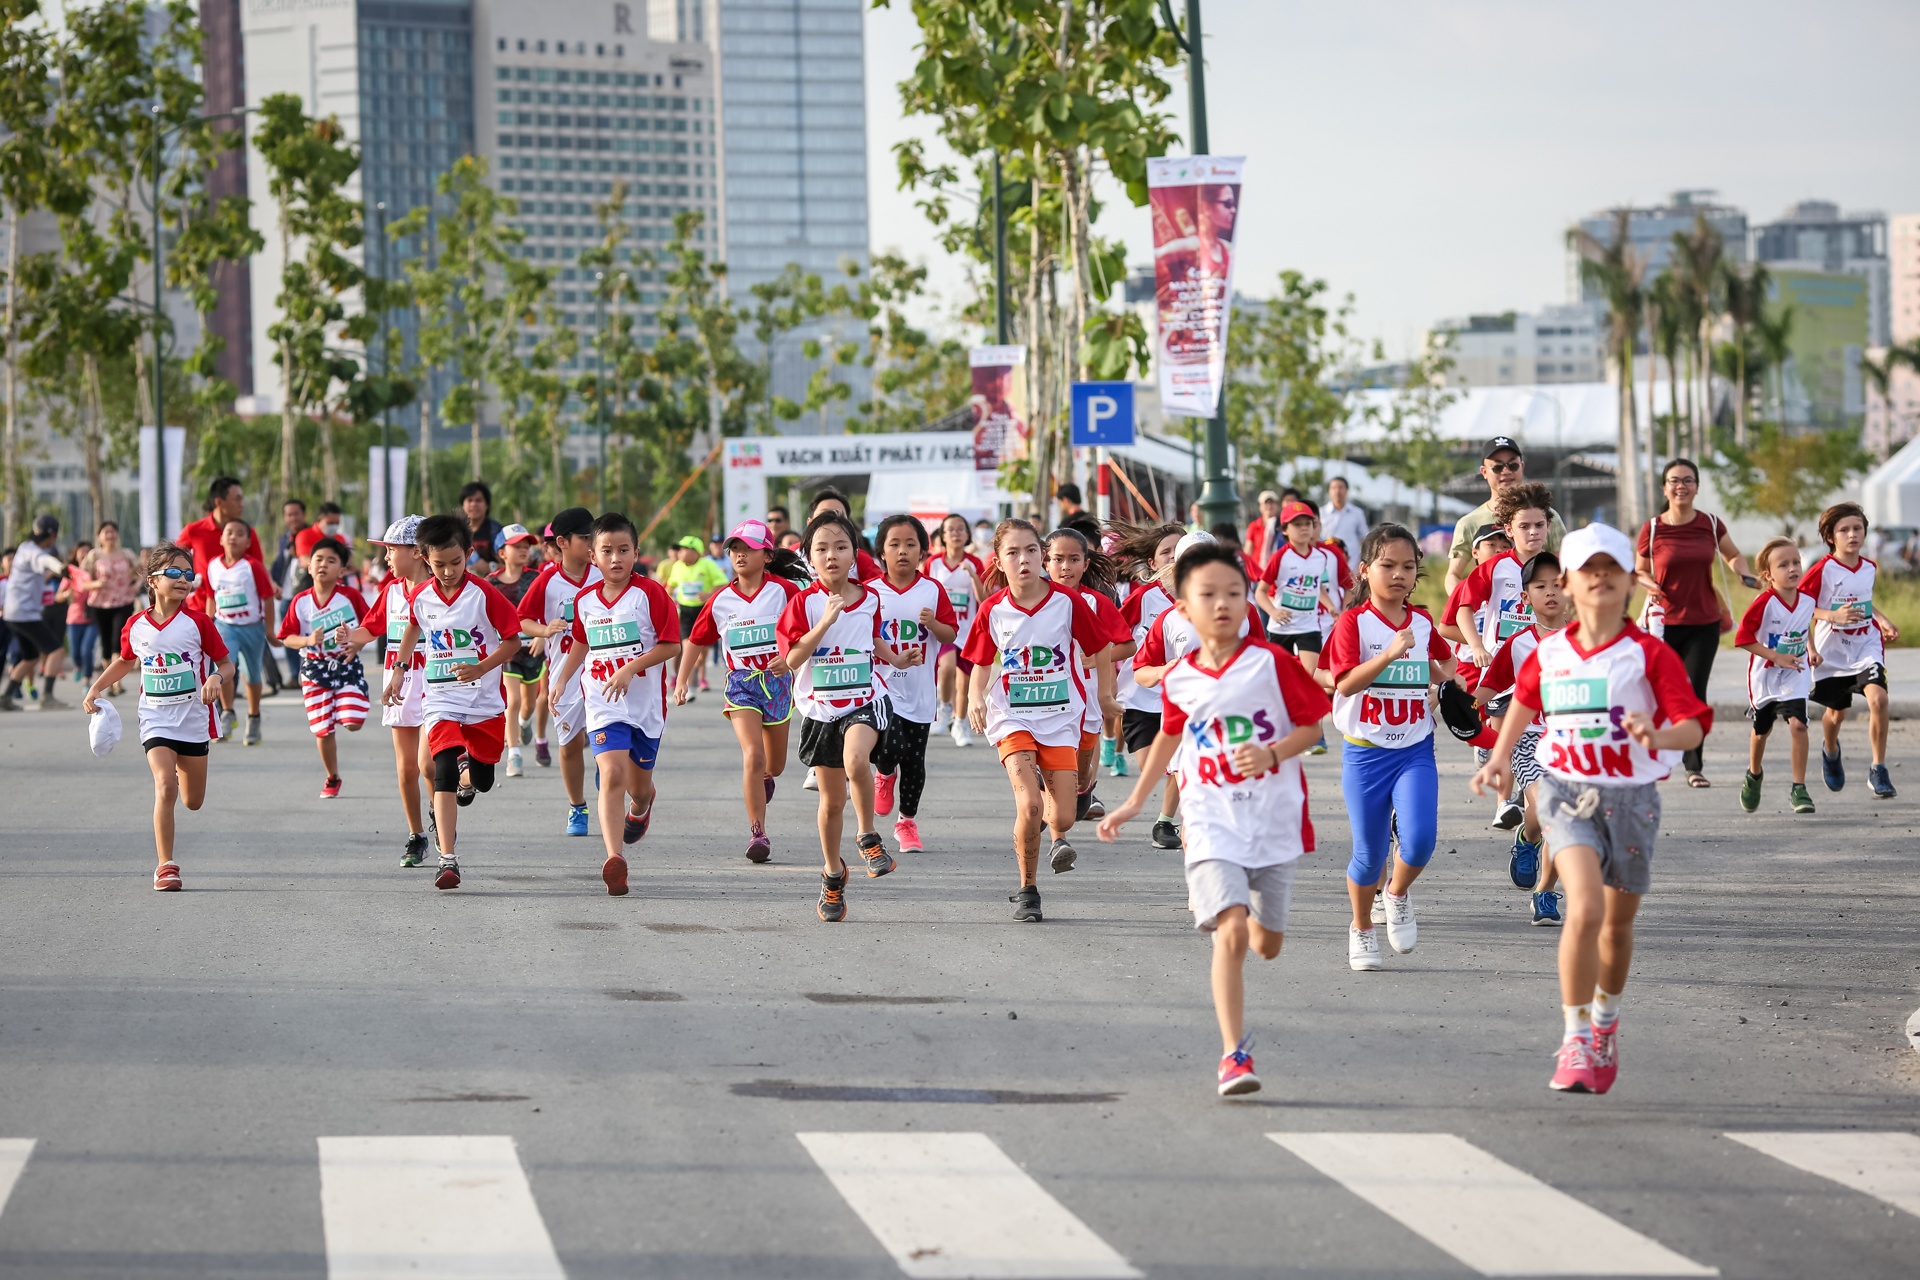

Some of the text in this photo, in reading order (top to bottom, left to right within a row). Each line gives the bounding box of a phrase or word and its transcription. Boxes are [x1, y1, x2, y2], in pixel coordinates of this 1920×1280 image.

[1088, 395, 1118, 433] P
[941, 446, 976, 466] VẠC
[1290, 596, 1312, 607] 7217
[320, 610, 345, 630] 7152
[1504, 612, 1531, 621] KIDSRUN
[431, 625, 484, 650] KIDS
[597, 626, 627, 645] 7158
[739, 627, 769, 643] 7170
[879, 618, 929, 642] KIDS
[1003, 644, 1066, 671] KIDS
[823, 667, 858, 684] 7100
[1388, 665, 1421, 682] 7181
[152, 676, 182, 691] 7027
[1023, 685, 1058, 700] 7177
[1360, 694, 1425, 726] RUN
[1188, 708, 1275, 751] KIDS
[1385, 733, 1405, 741] 2017
[1548, 742, 1634, 777] RUN
